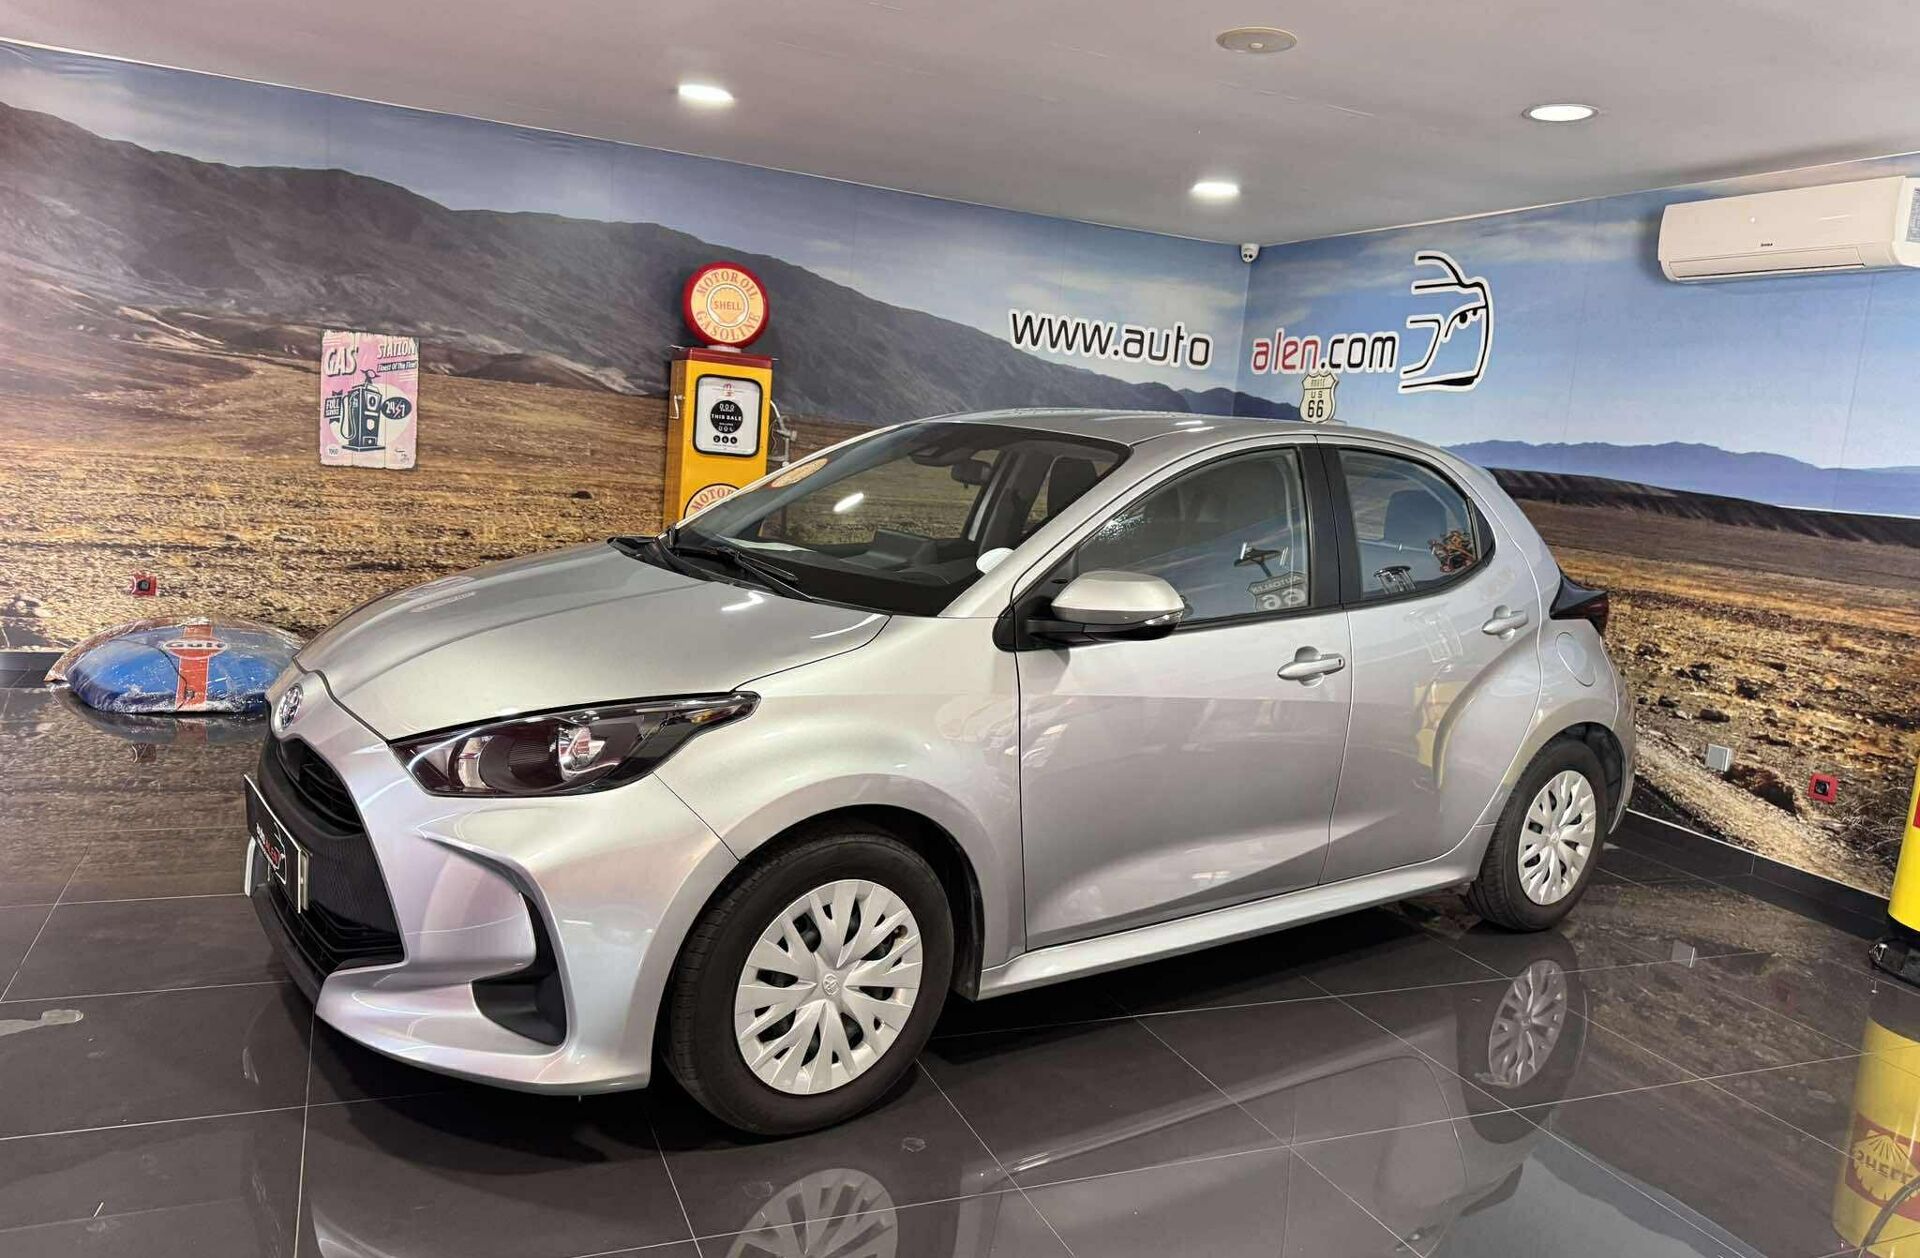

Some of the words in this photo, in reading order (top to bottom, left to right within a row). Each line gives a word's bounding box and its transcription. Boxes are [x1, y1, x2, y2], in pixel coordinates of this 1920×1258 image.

[696, 270, 739, 297] MOTOR
[740, 278, 759, 300] OIL
[713, 301, 742, 311] SHELL
[695, 310, 761, 341] GASOLINE
[377, 337, 417, 359] STATION
[1011, 312, 1211, 367] www.auto
[1253, 331, 1396, 371] alen.com
[325, 347, 358, 377] GAS
[1307, 399, 1324, 418] 66
